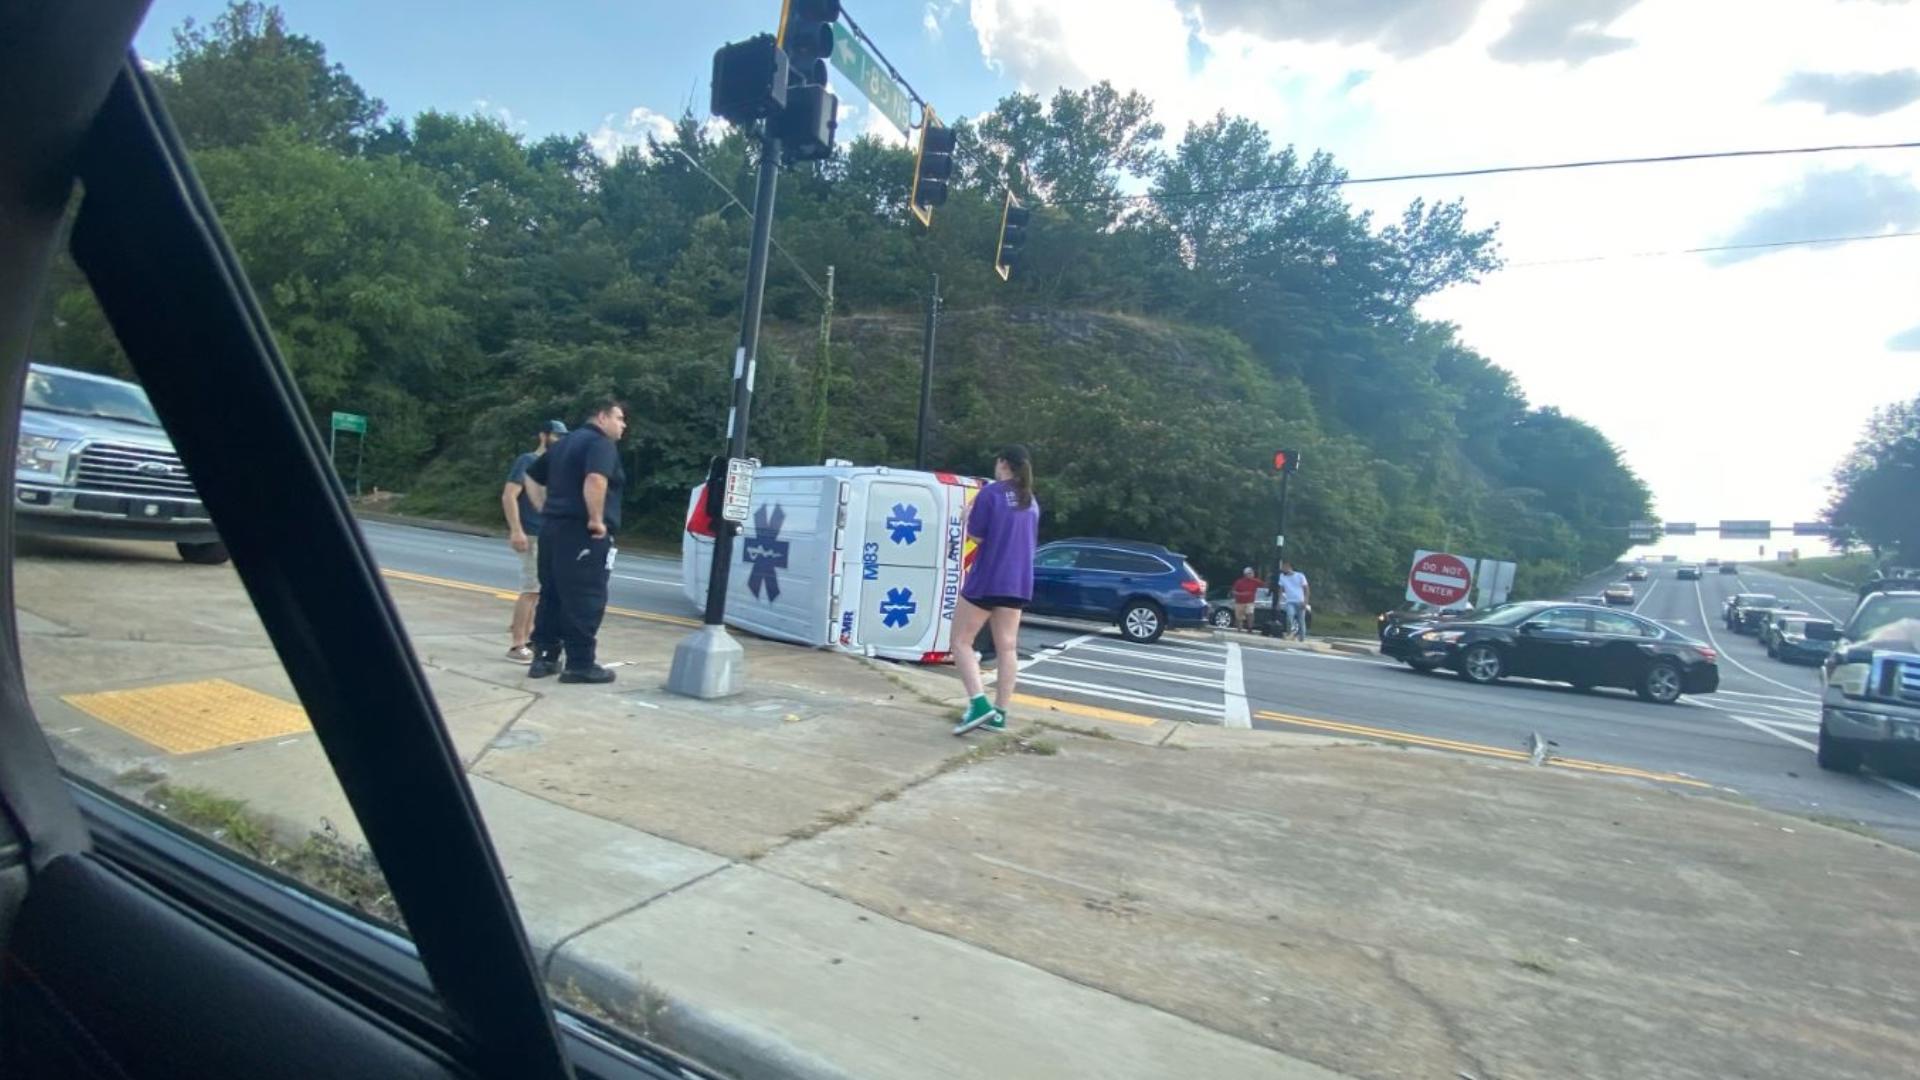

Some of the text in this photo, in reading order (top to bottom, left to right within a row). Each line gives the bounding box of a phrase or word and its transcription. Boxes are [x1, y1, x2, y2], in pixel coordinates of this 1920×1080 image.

[861, 55, 889, 104] I-85
[863, 542, 879, 580] M83
[942, 516, 961, 620] AMBULANCE
[1423, 562, 1463, 575] DO NOT
[1422, 584, 1453, 596] ENTER
